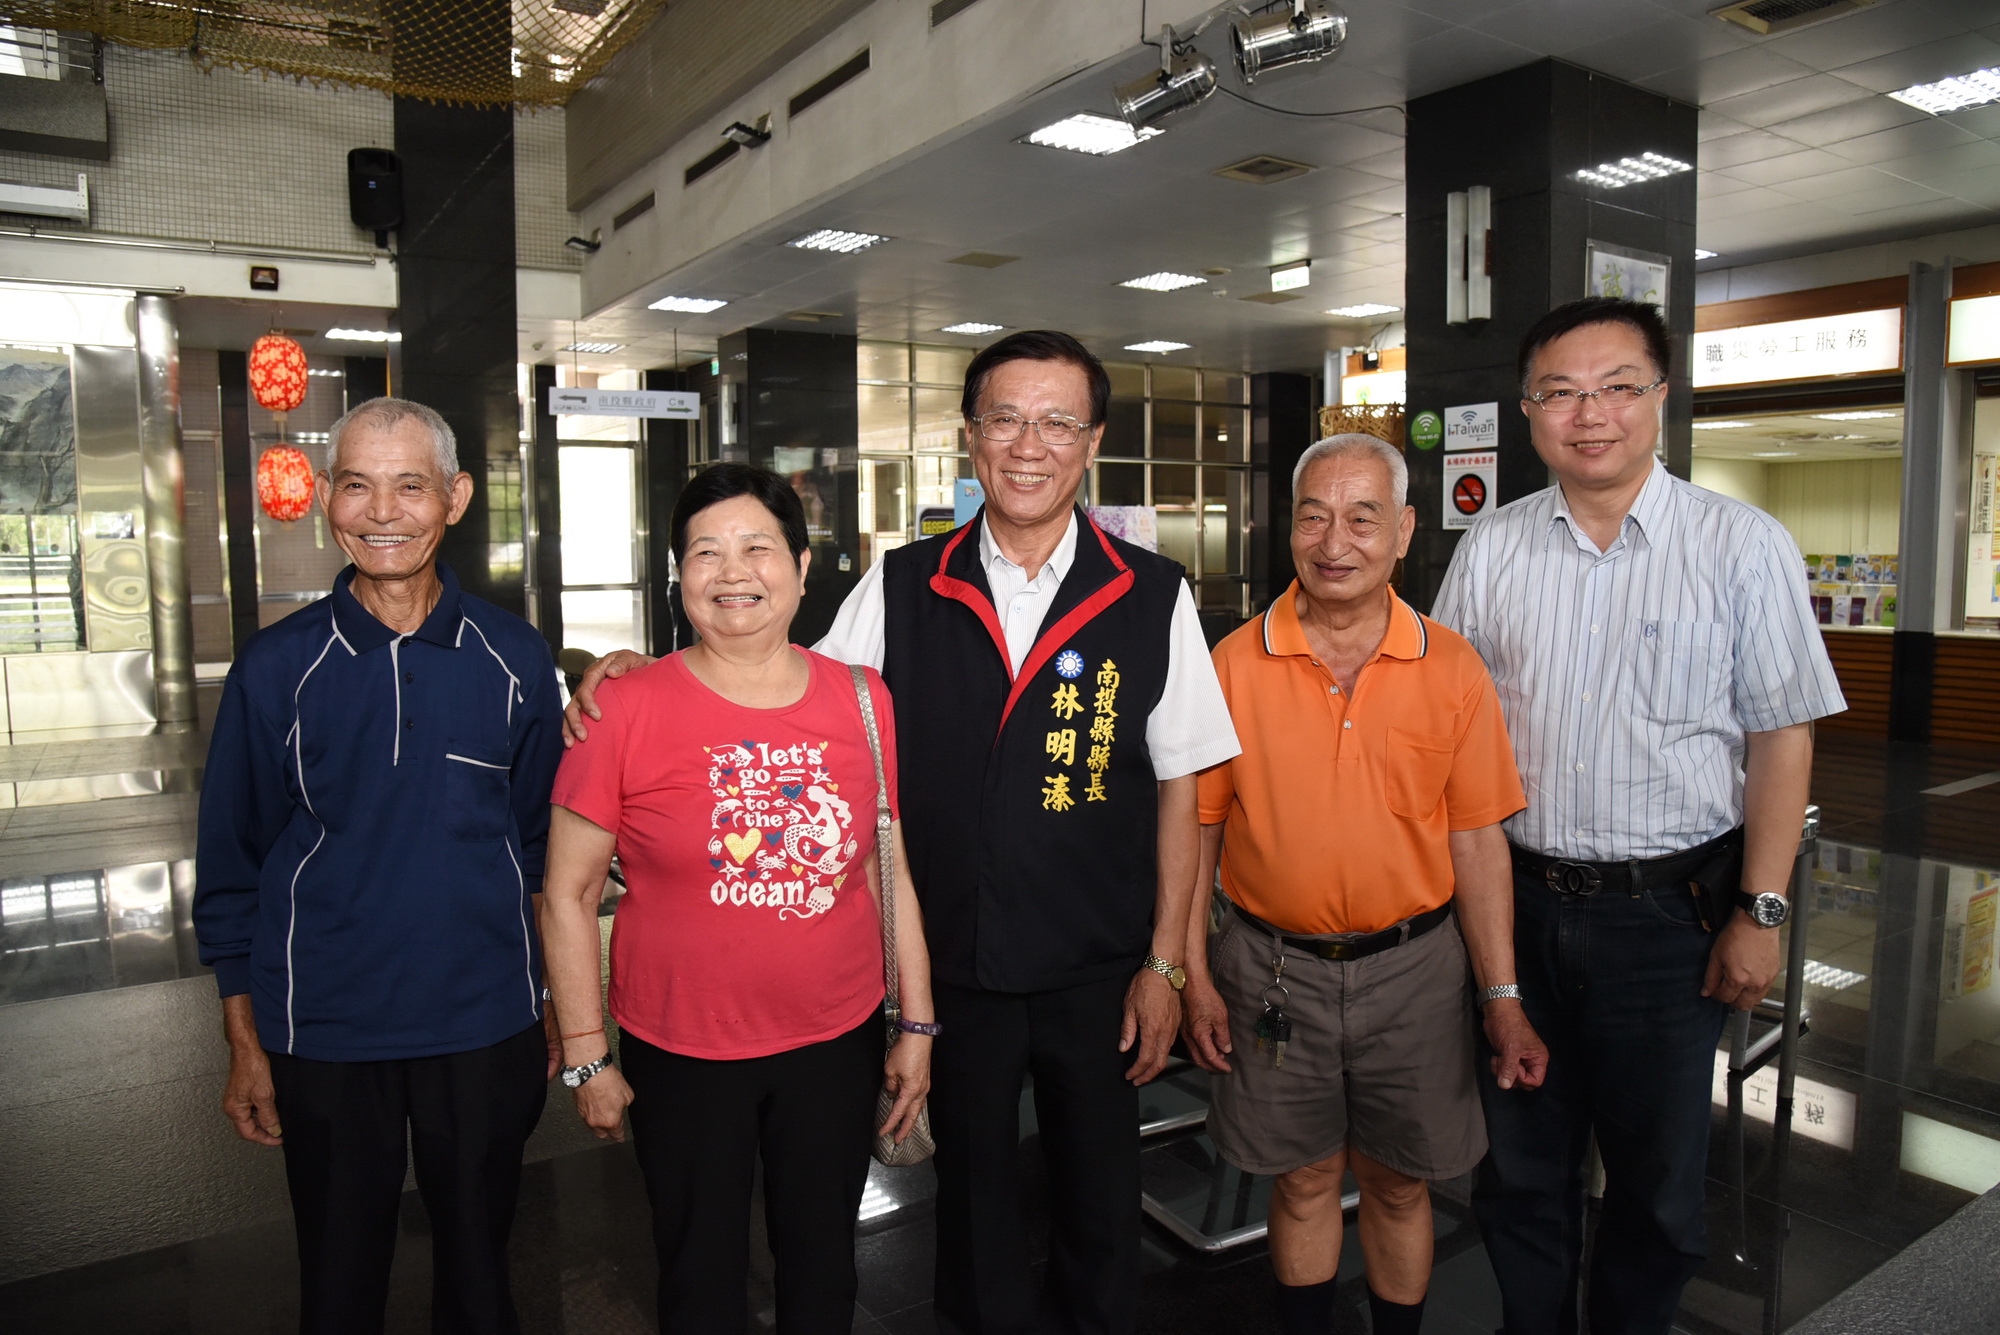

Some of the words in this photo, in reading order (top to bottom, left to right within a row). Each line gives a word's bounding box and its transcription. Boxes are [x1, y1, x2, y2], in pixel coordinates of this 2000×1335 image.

[1706, 328, 1867, 363] 職災勞工服務
[1084, 658, 1120, 802] 南投縣縣長
[756, 741, 823, 767] let's
[1041, 682, 1085, 812] 林明溱
[739, 767, 771, 789] go
[745, 797, 770, 811] to
[743, 811, 784, 828] the
[710, 879, 804, 907] ocean
